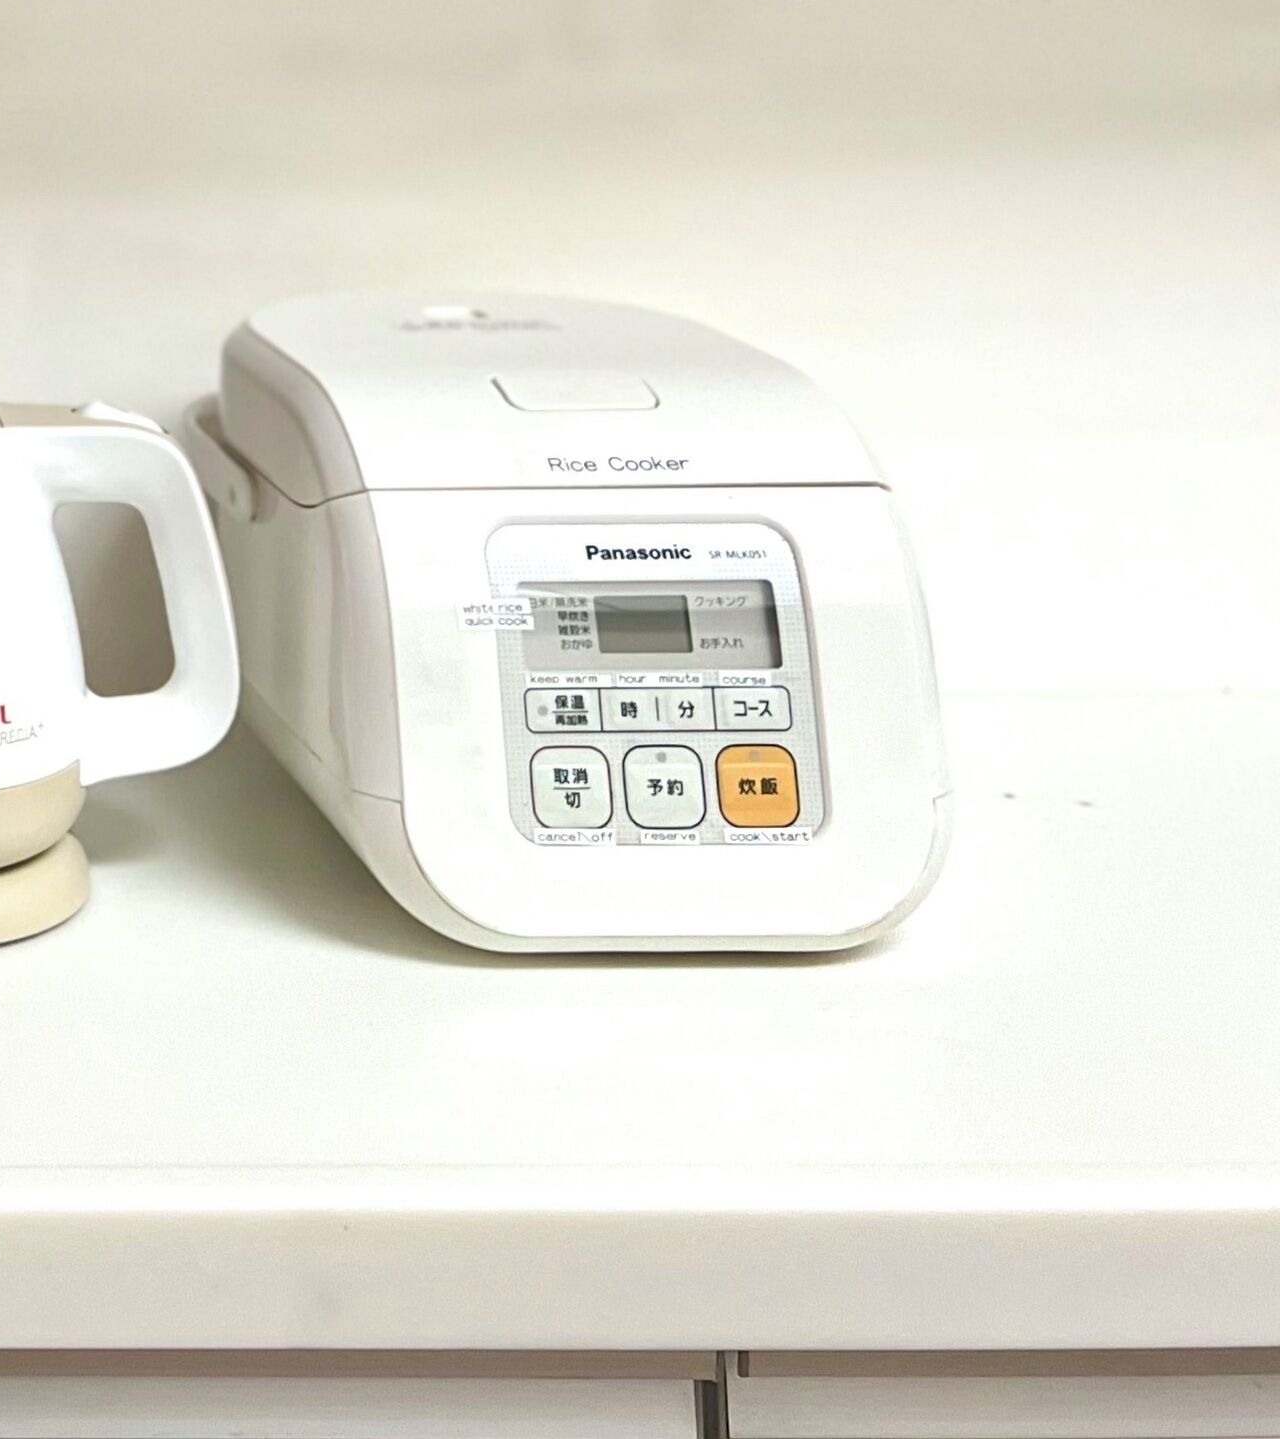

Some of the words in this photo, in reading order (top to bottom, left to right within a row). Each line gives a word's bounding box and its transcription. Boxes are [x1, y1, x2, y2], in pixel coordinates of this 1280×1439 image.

[547, 457, 598, 472] Rice
[607, 456, 689, 472] Cooker
[585, 544, 692, 560] Panasonic
[498, 602, 523, 613] rice
[695, 596, 748, 607] クッキング
[498, 615, 528, 626] cook
[700, 638, 744, 650] お手入れ
[530, 674, 559, 684] keep
[565, 675, 598, 683] warm
[619, 674, 646, 684] hour
[659, 673, 700, 684] minute
[722, 676, 766, 685] course
[555, 695, 585, 709] 保温
[678, 701, 695, 718] 分
[733, 700, 773, 718] コース
[620, 701, 638, 719] 時
[553, 768, 588, 785] 取消
[646, 778, 684, 797] 予約
[738, 777, 778, 796] 炊飯
[564, 792, 581, 809] 切
[644, 831, 697, 841] reserve
